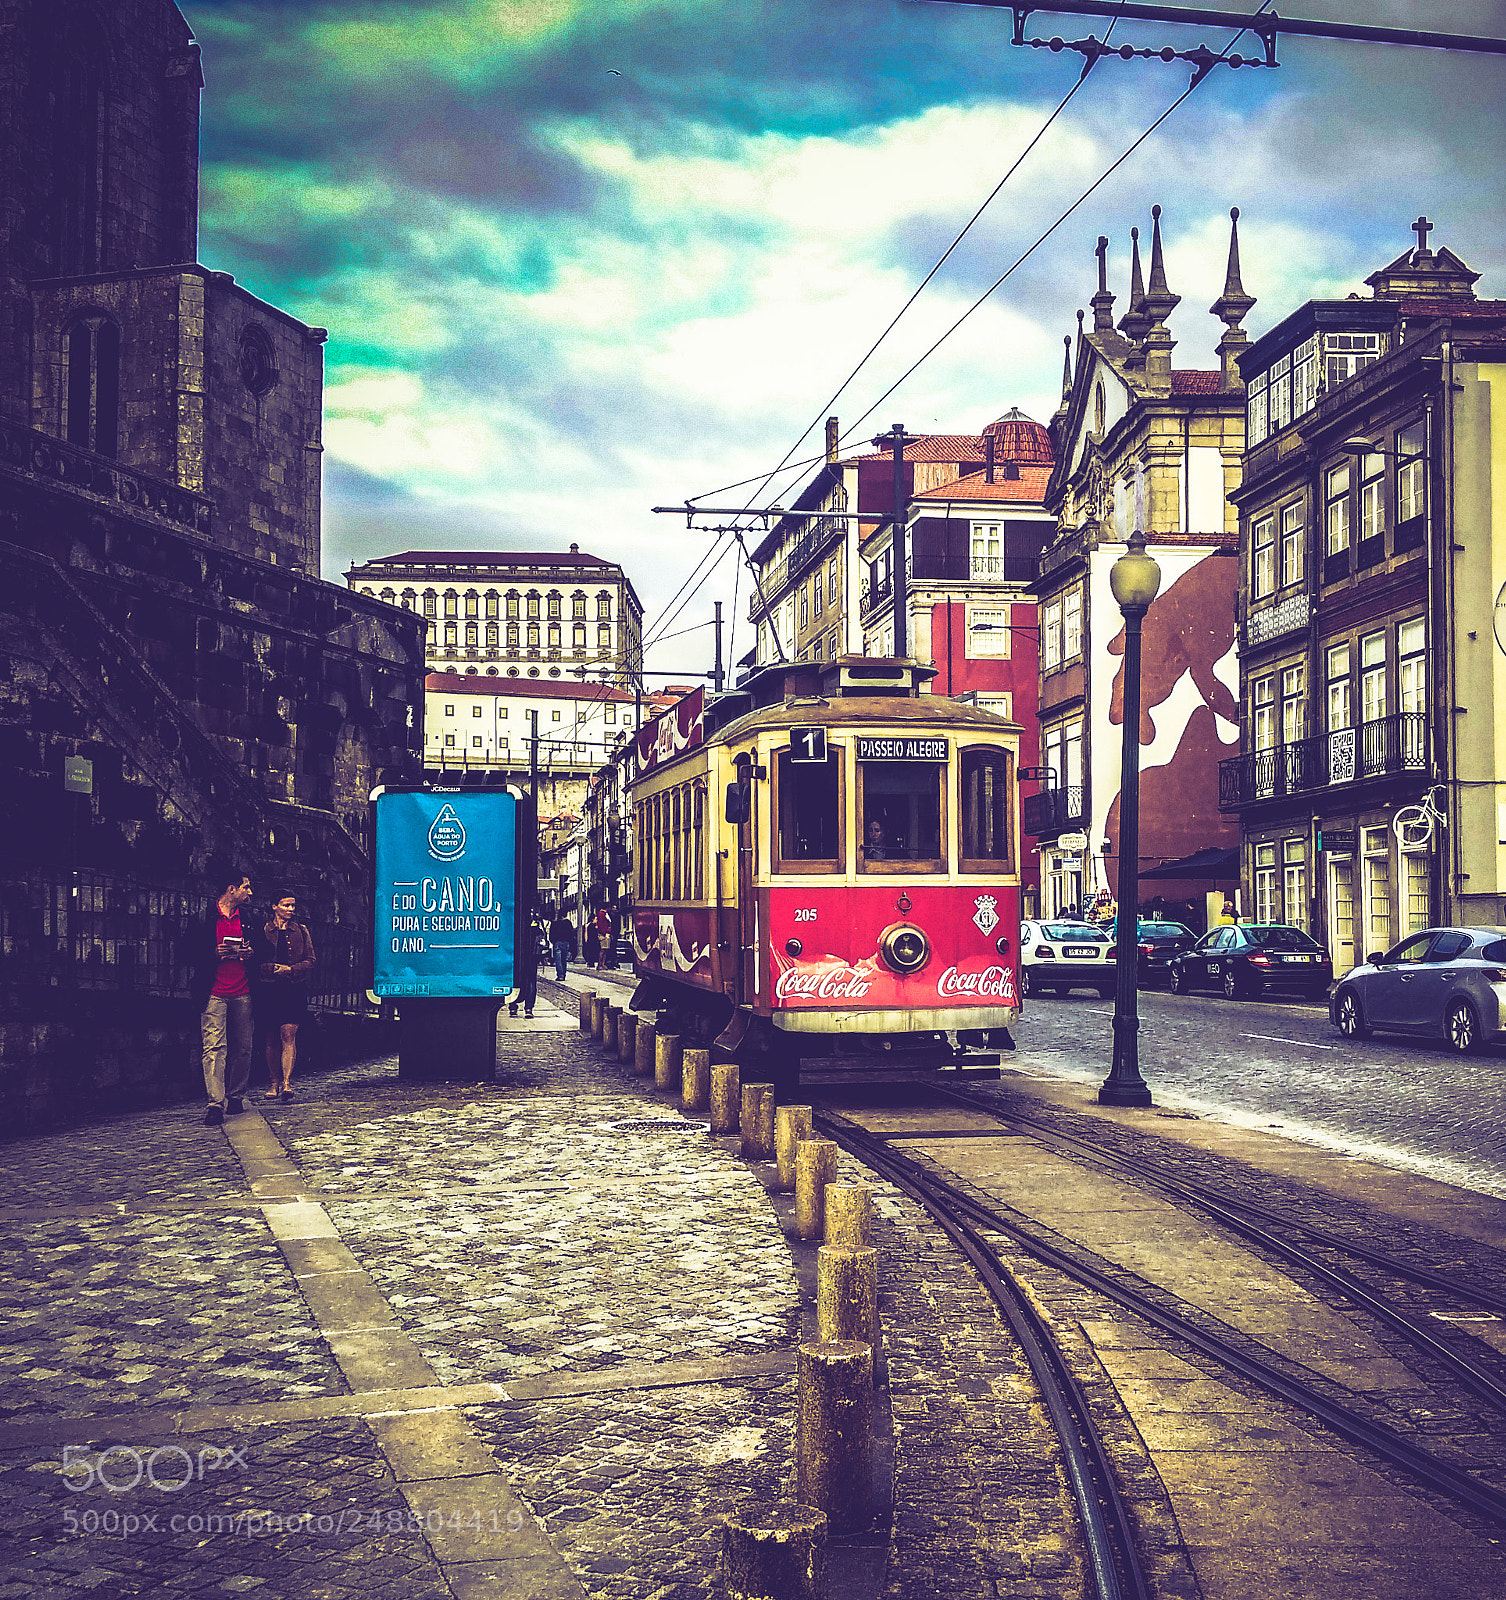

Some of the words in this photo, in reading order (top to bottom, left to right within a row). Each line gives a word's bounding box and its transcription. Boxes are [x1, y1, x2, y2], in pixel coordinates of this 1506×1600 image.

[801, 732, 814, 757] 1
[860, 740, 904, 757] PASSEIO
[906, 741, 945, 758] ALEGRE
[392, 893, 400, 910] É
[402, 894, 416, 910] DO
[420, 875, 501, 913] CANO,
[392, 916, 420, 931] PURA
[422, 916, 429, 931] E
[431, 916, 471, 931] SEGURA
[473, 916, 500, 931] TODO
[794, 908, 818, 922] 205
[391, 937, 399, 953] O
[401, 937, 427, 953] ANO.
[776, 966, 874, 999] Coca-Cola
[937, 965, 1014, 999] Coca-Cola
